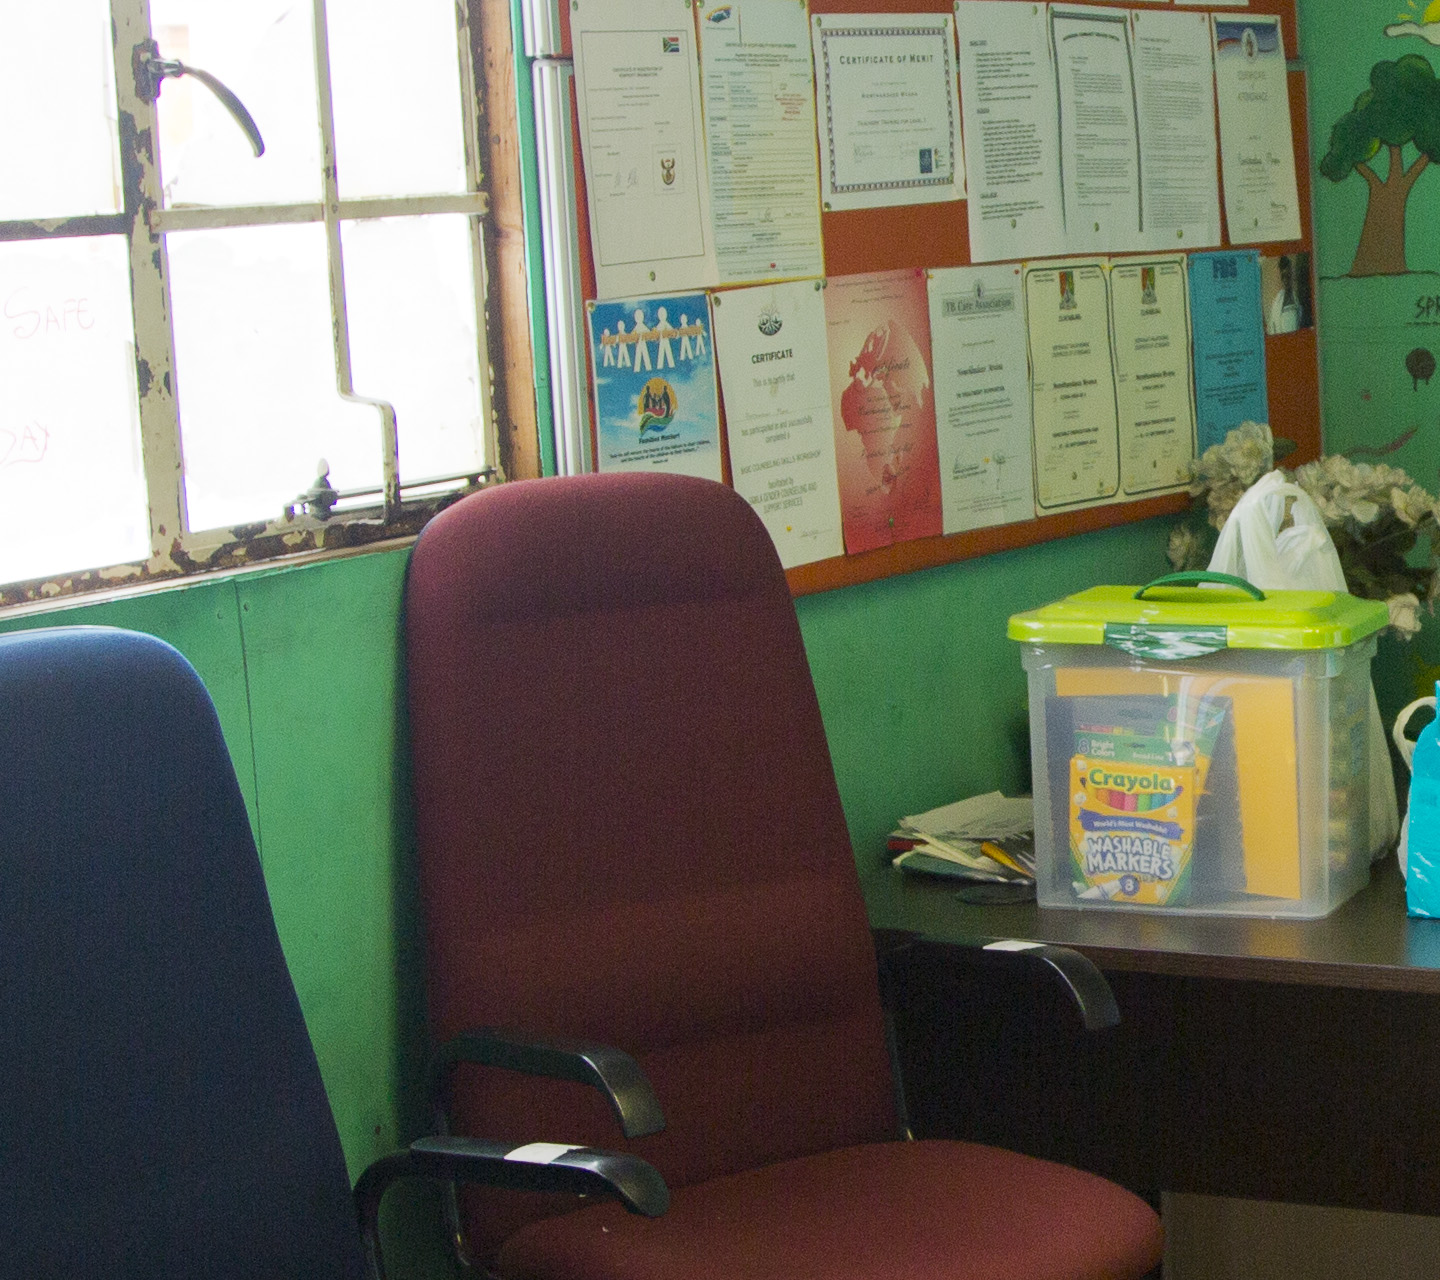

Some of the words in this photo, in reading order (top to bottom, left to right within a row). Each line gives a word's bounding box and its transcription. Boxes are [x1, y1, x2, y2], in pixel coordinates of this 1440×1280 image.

[839, 55, 893, 65] CERTIFICATE
[897, 55, 906, 63] OF
[909, 54, 933, 63] MERIT
[4, 286, 95, 340] SAFE
[751, 348, 793, 365] CERTIFICATE
[1089, 768, 1175, 792] Crayola
[1086, 834, 1172, 860] WASHABLE
[1086, 853, 1173, 880] MARKERS
[1124, 878, 1135, 892] 8
